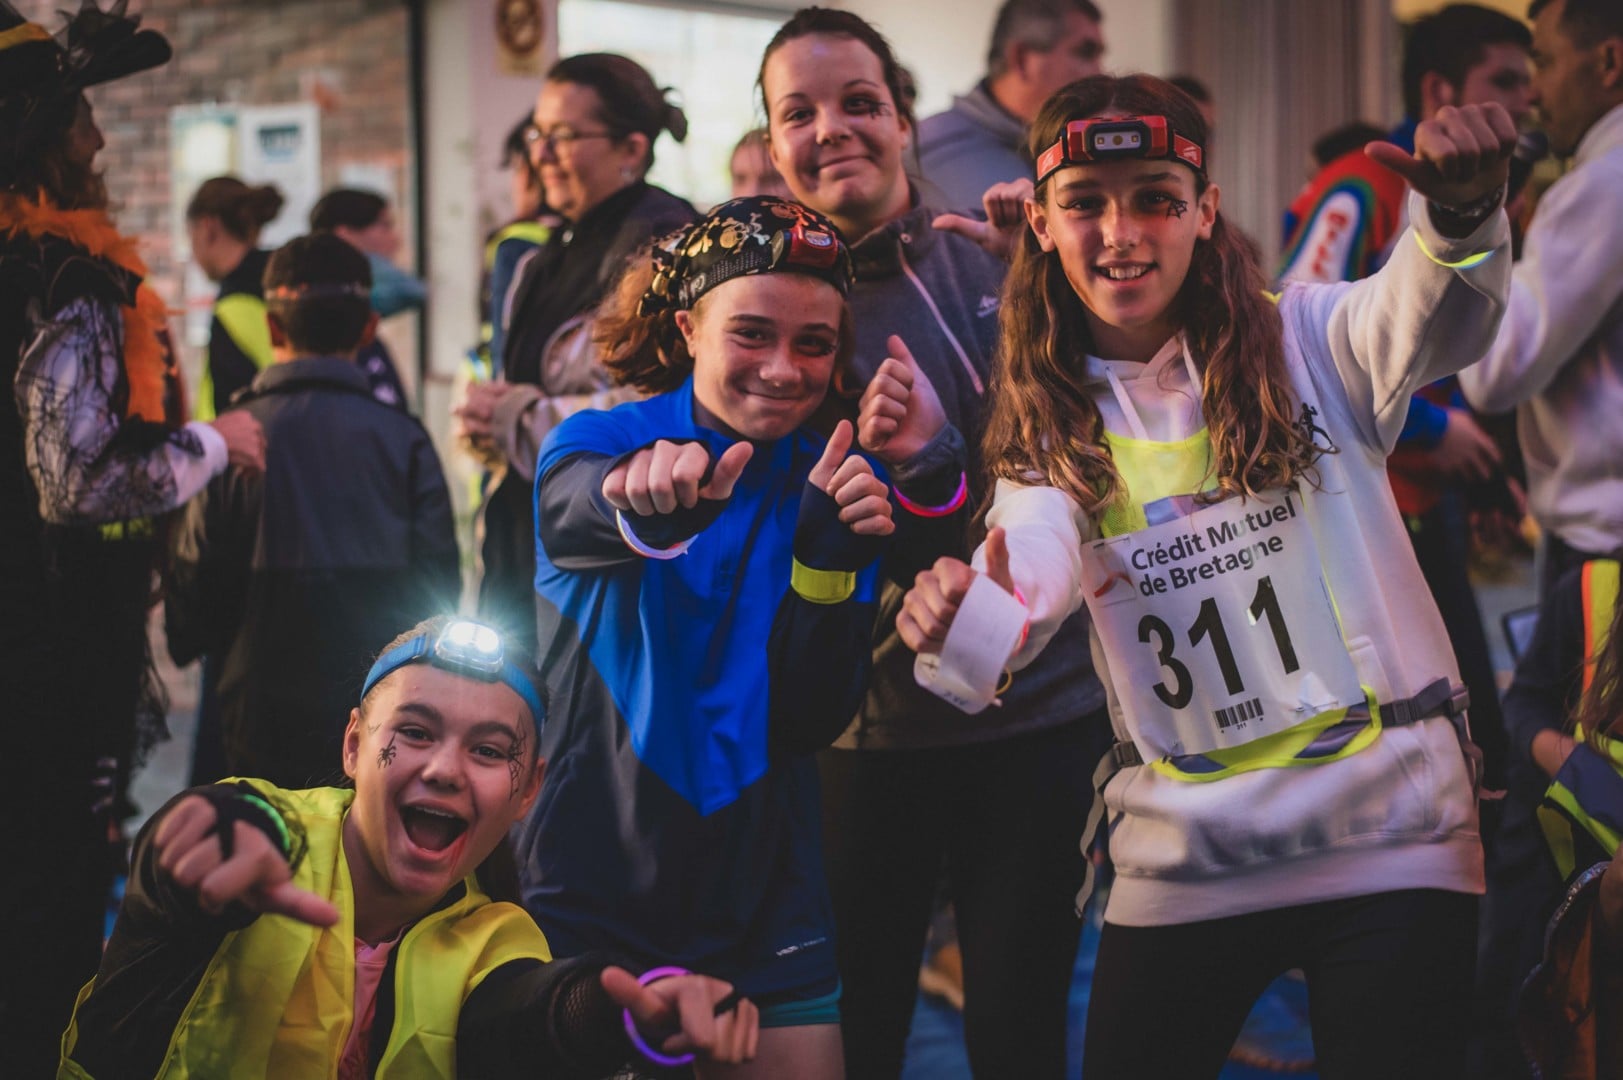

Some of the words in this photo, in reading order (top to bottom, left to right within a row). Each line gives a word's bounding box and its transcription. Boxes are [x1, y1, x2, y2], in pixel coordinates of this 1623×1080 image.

[1131, 534, 1206, 571] Crédit
[1206, 496, 1296, 544] Mutuel
[1139, 574, 1167, 596] de
[1168, 535, 1284, 590] Bretagne
[1137, 575, 1300, 710] 311
